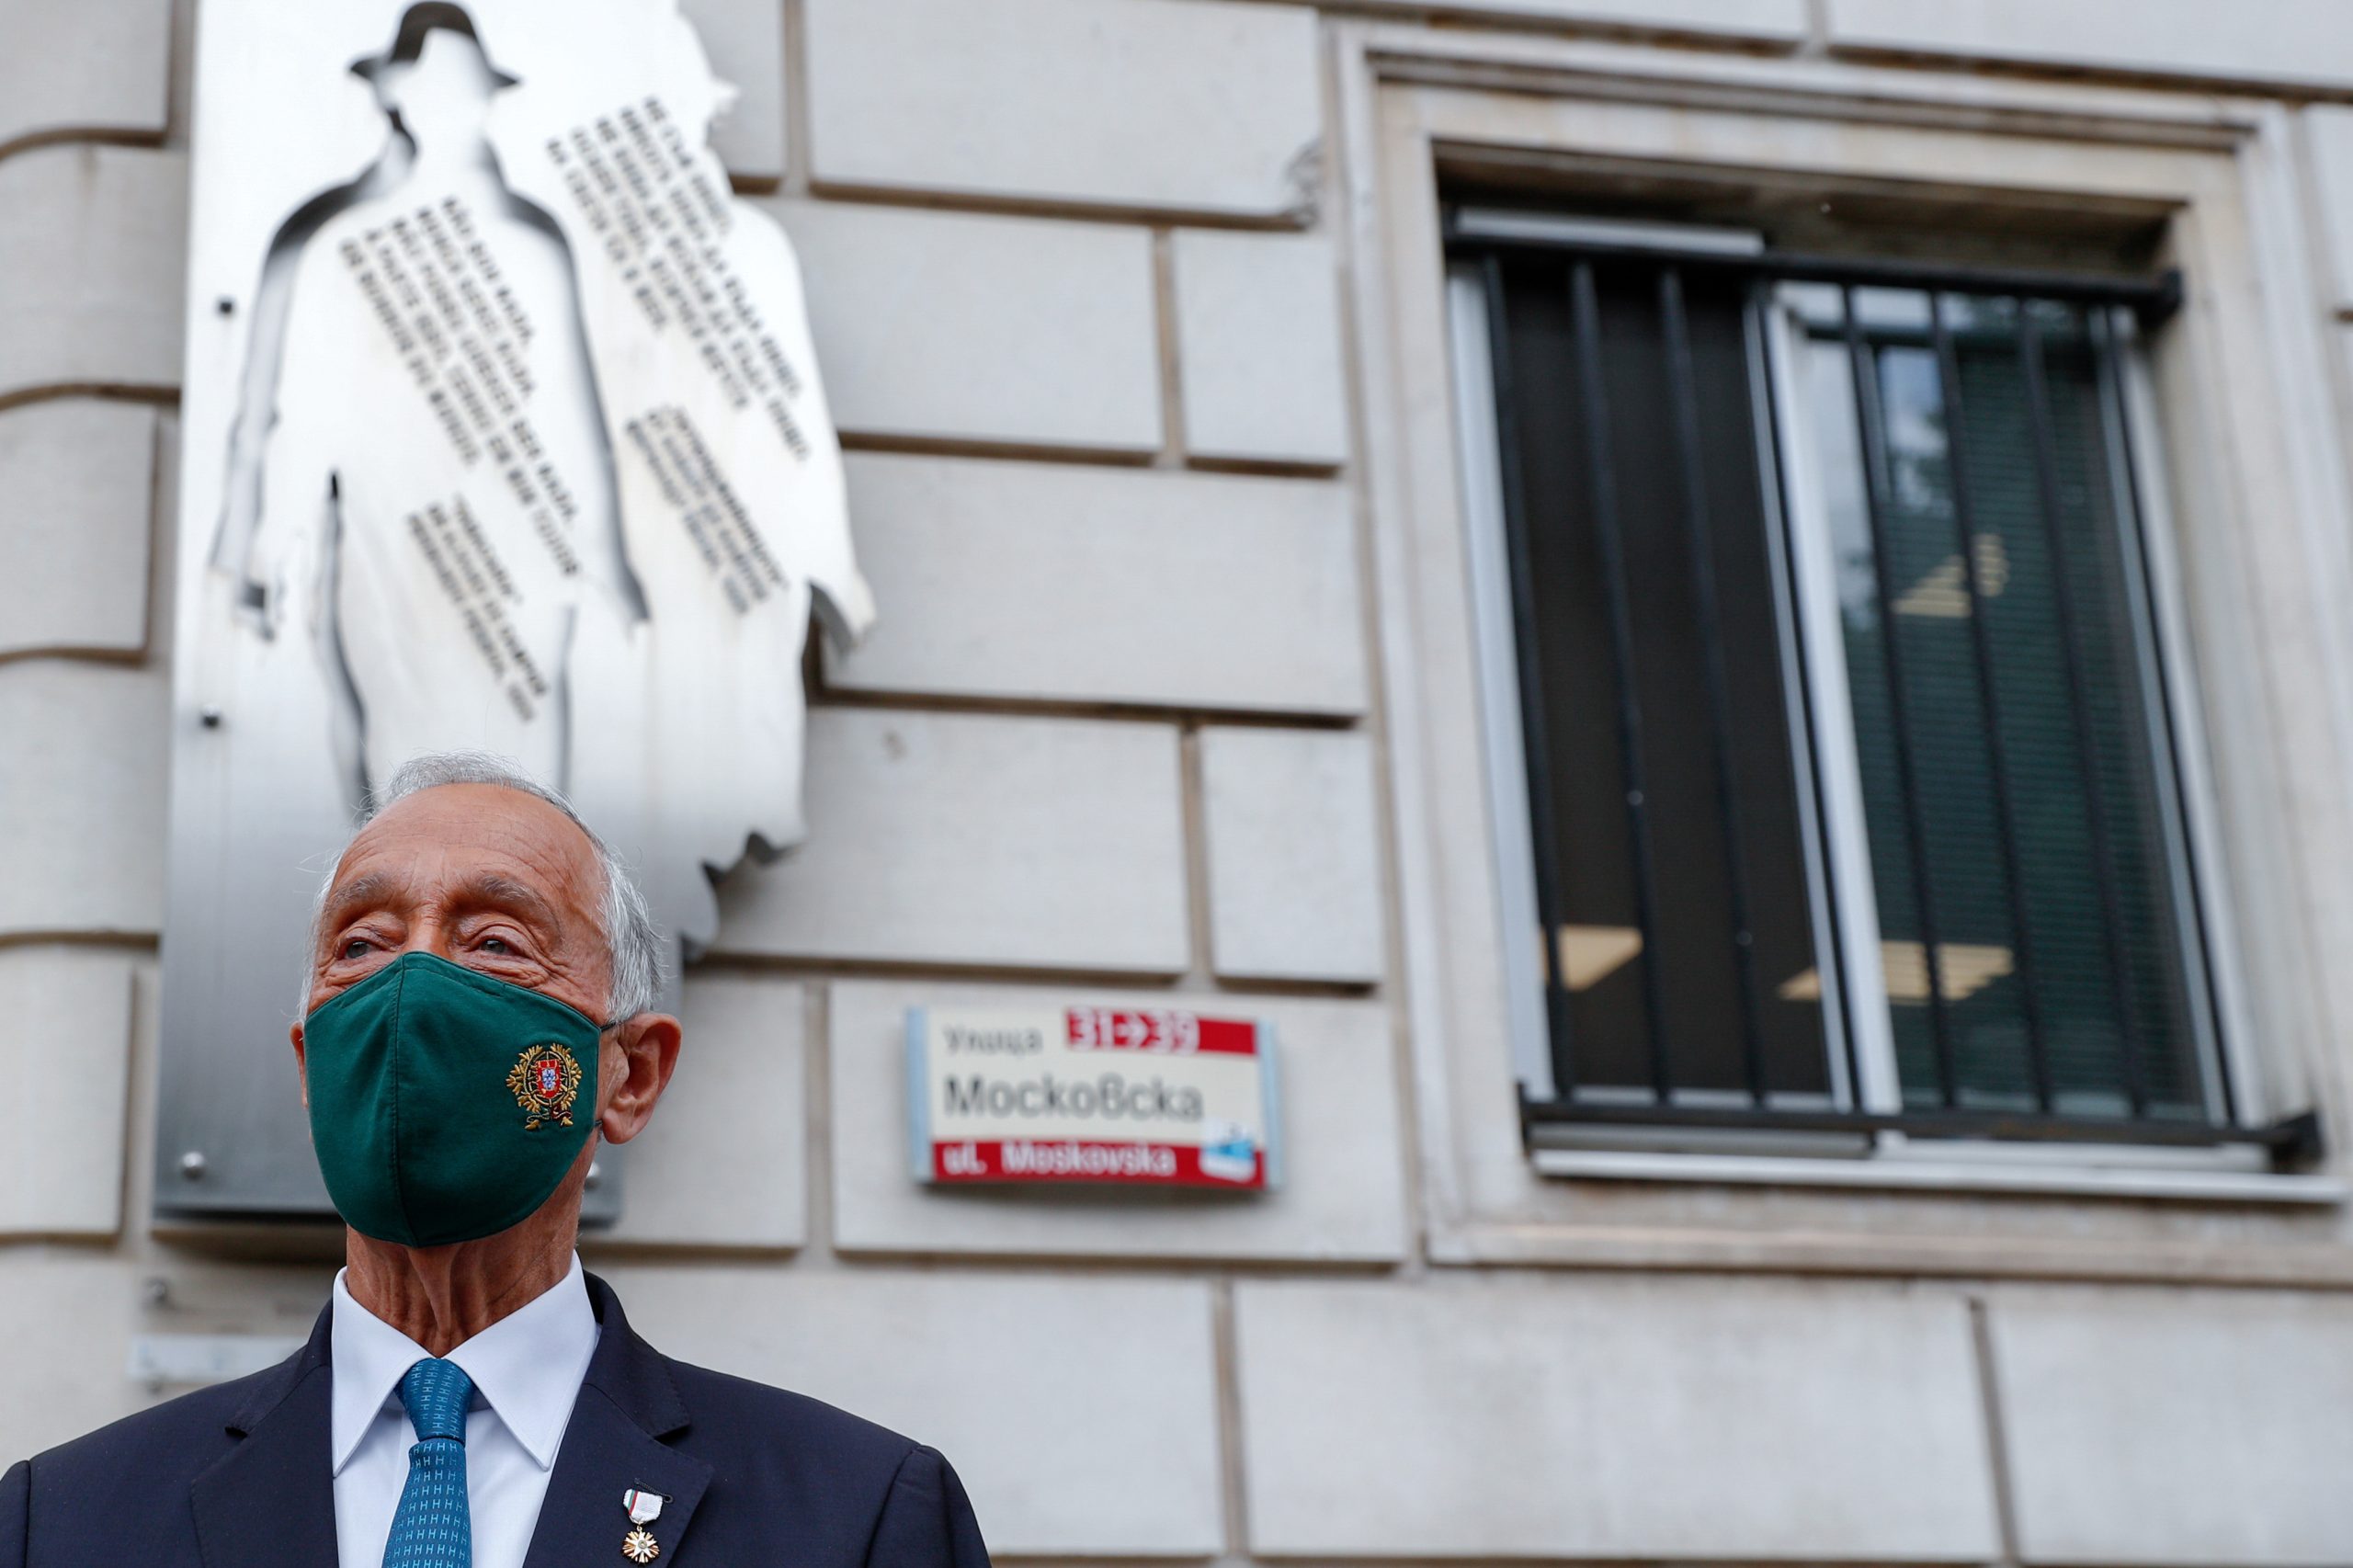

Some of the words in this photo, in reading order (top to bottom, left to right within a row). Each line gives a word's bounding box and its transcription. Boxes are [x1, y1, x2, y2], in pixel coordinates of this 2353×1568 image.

[942, 1024, 1044, 1057] Улица
[944, 1074, 1205, 1122] Московска
[943, 1143, 986, 1175] ul.
[1002, 1142, 1176, 1176] Moskovska
